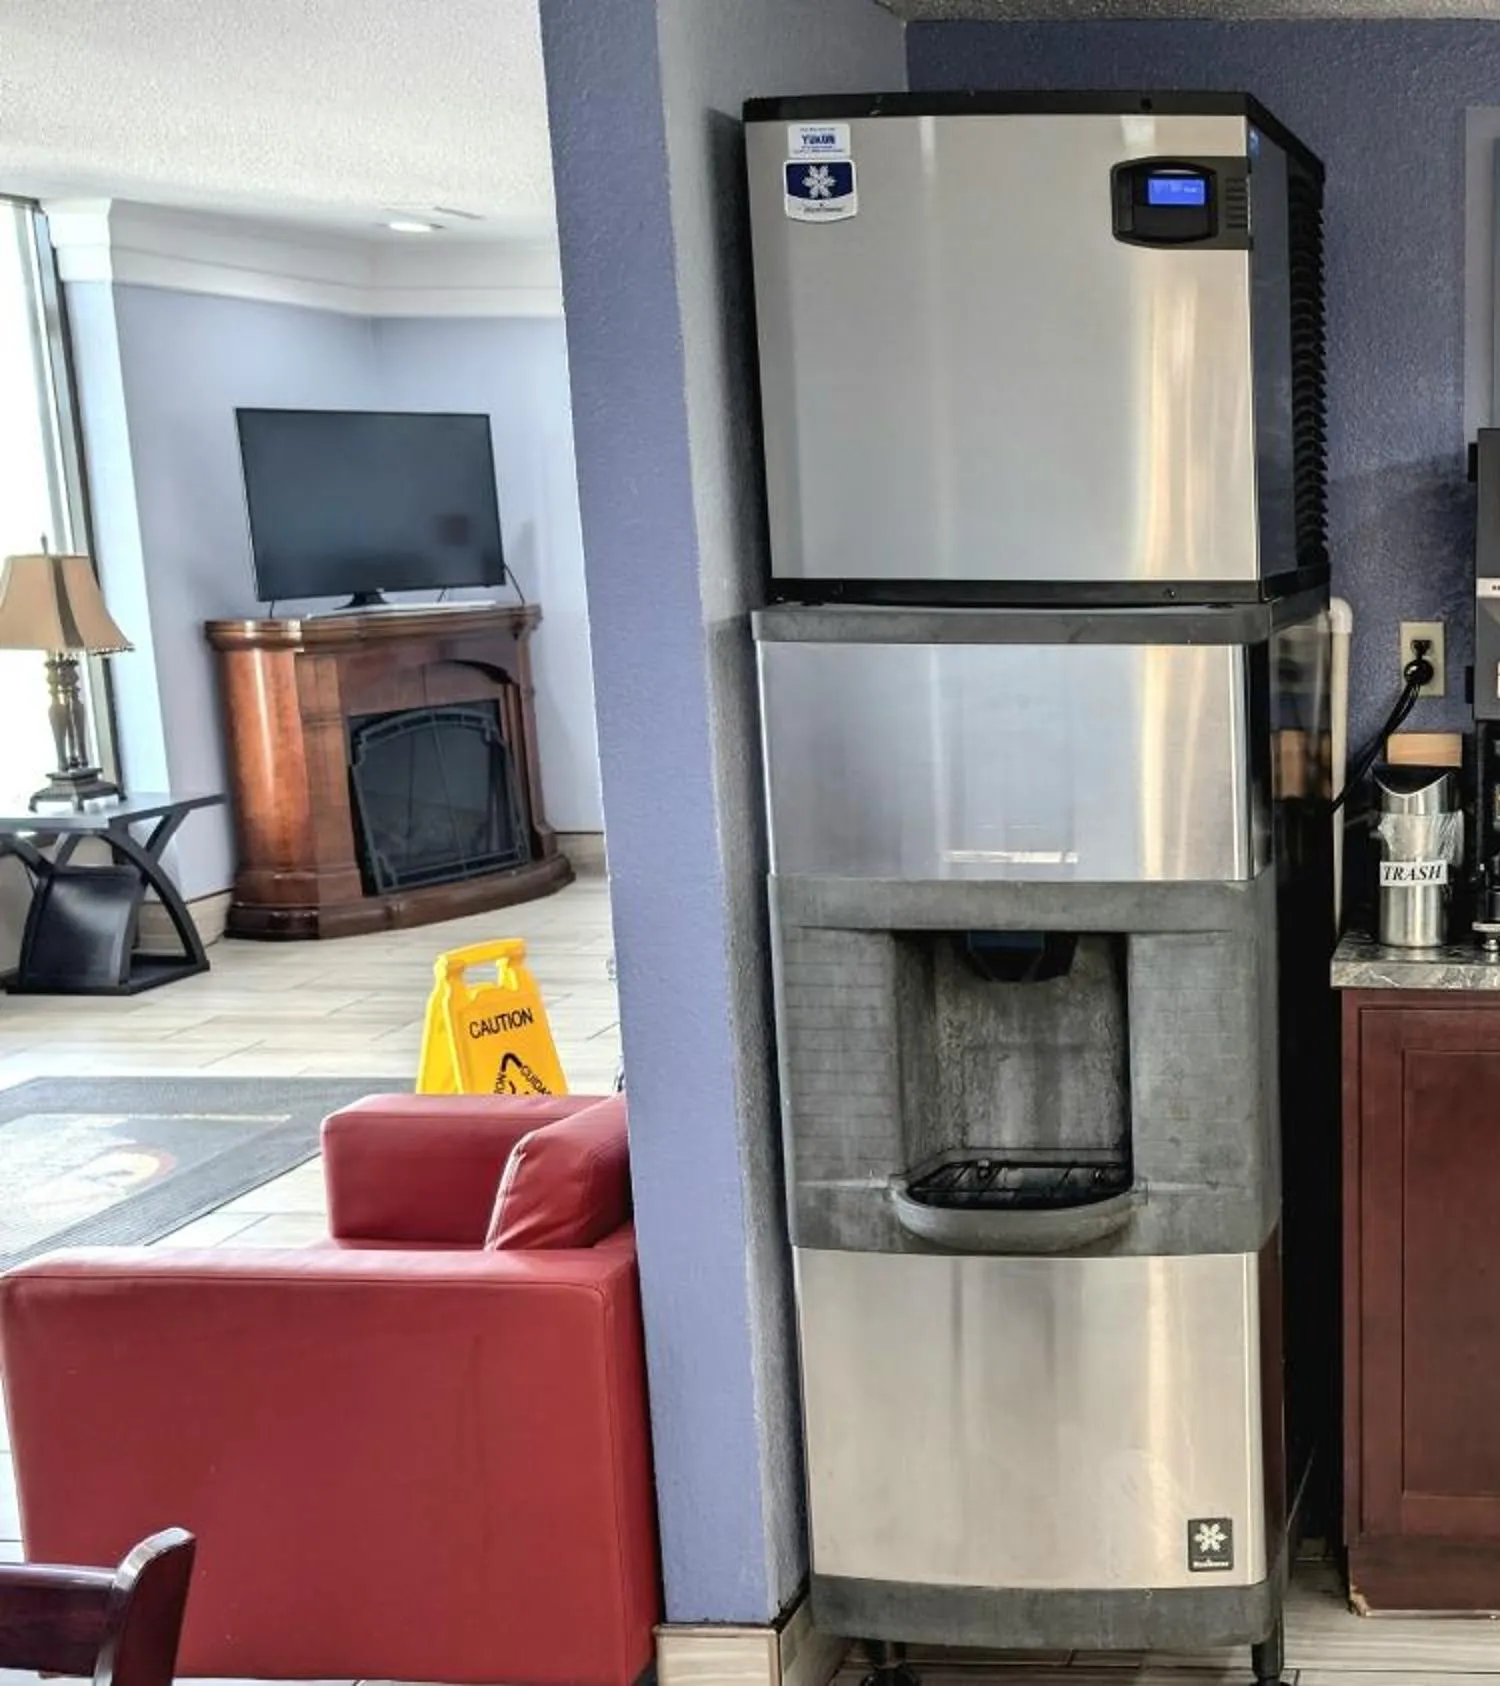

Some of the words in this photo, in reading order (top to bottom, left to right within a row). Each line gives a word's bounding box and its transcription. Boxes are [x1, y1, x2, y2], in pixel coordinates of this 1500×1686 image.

[1383, 865, 1441, 881] TRASH
[468, 1007, 534, 1040] CAUTION
[520, 1064, 552, 1095] CUIDA
